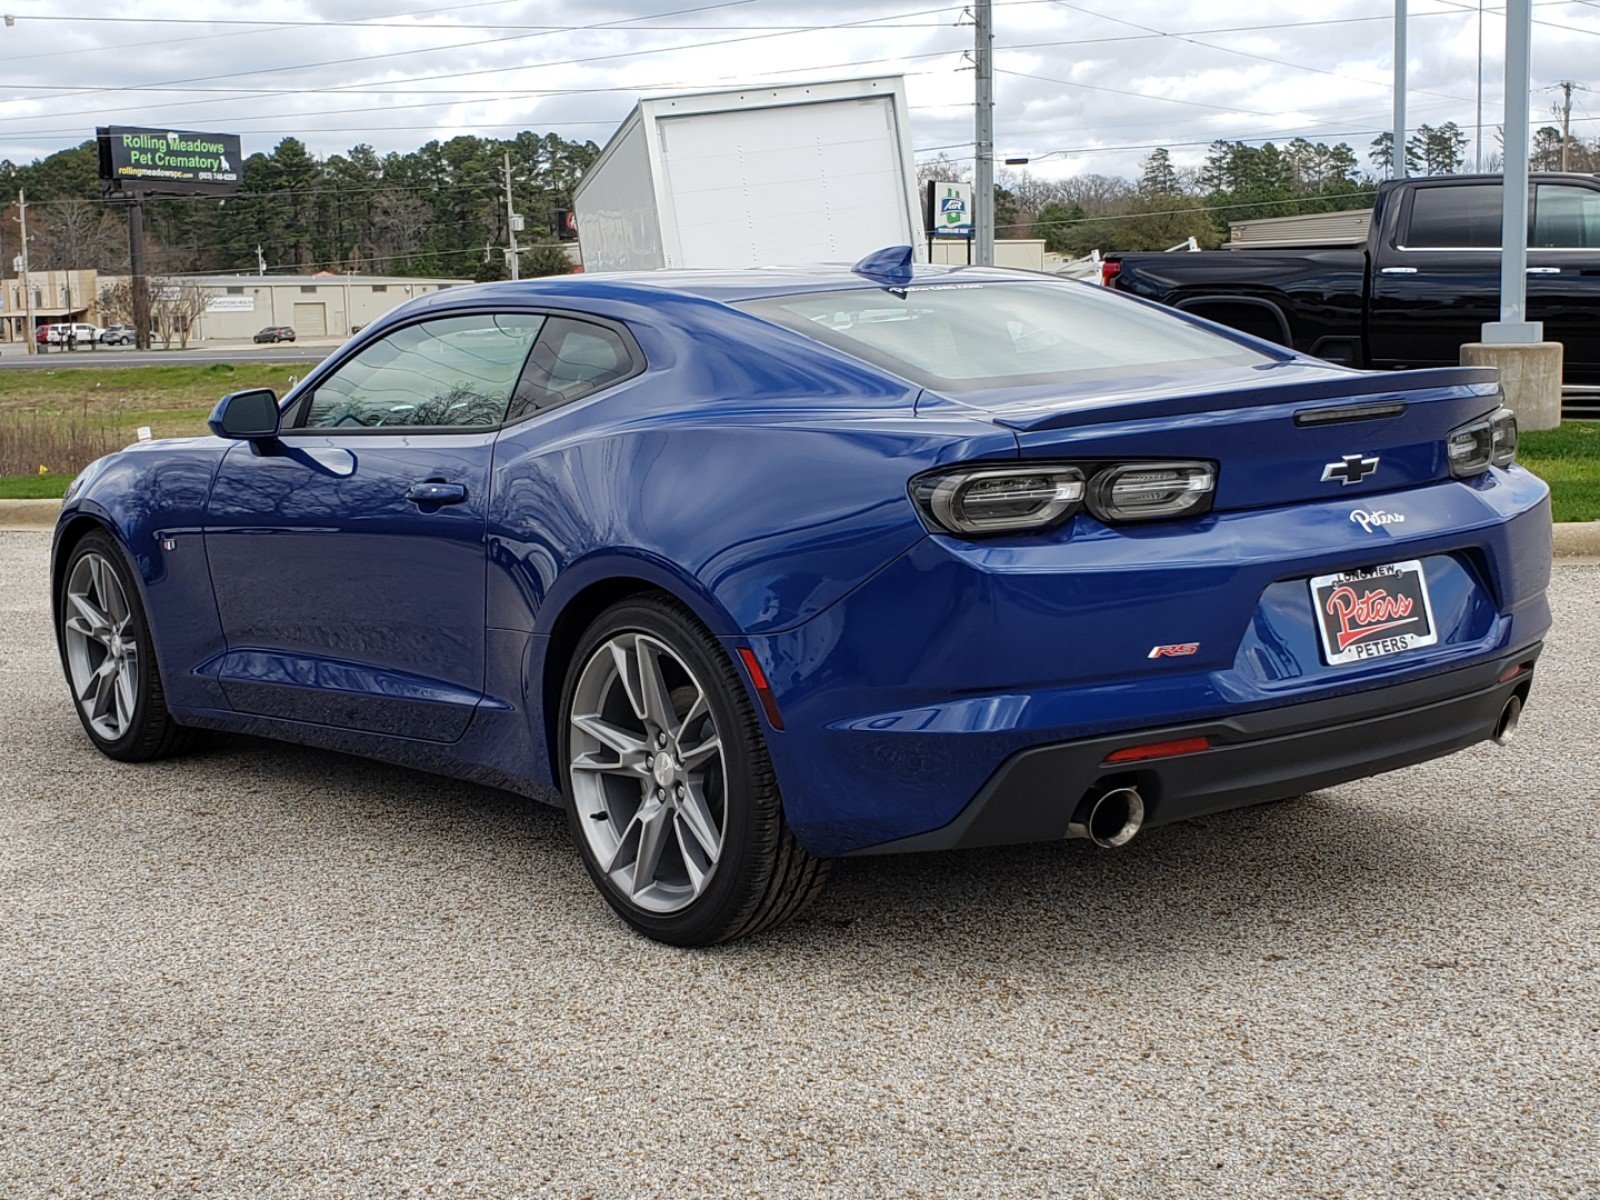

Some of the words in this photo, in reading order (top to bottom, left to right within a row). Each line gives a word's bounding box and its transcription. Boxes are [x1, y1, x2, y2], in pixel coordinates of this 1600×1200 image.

[122, 134, 167, 153] Rolling
[170, 137, 225, 154] Meadows
[131, 150, 152, 165] Pet
[155, 152, 219, 171] Crematory
[1349, 509, 1405, 533] Peters
[1326, 586, 1414, 637] Peters
[1147, 642, 1200, 658] RS
[1355, 636, 1408, 659] PETERS
